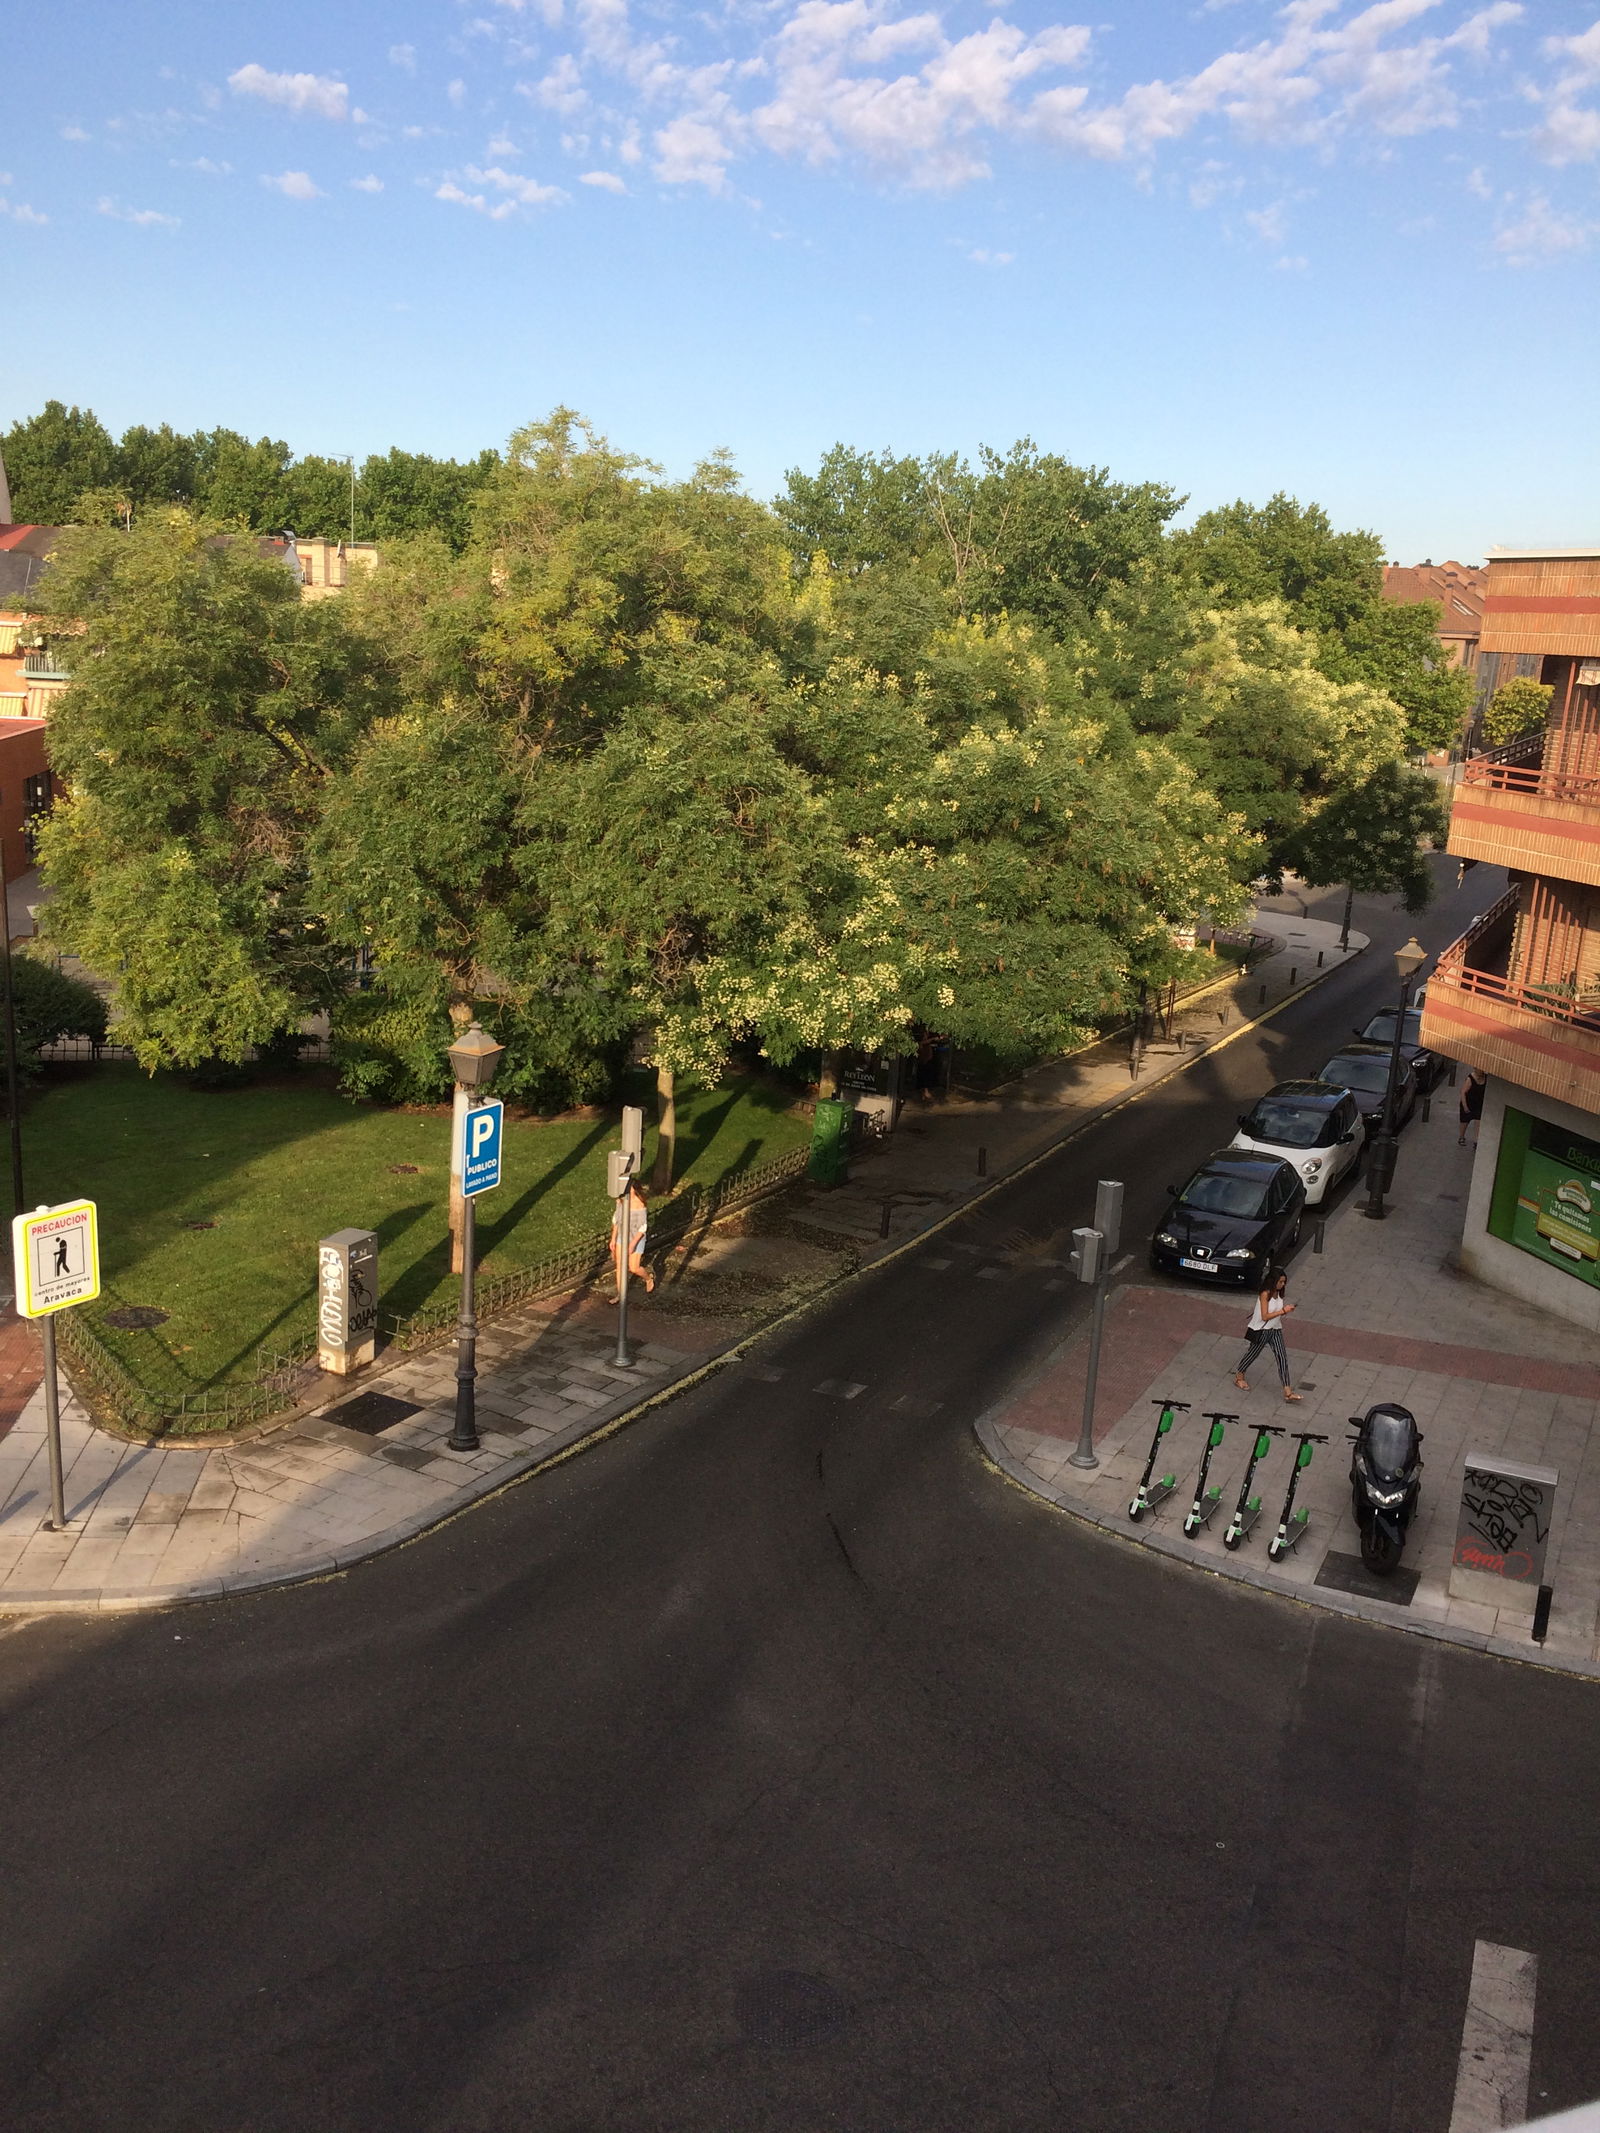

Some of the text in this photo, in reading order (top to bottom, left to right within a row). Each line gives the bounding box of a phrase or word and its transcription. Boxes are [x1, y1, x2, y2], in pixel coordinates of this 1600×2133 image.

[473, 1115, 494, 1158] P
[467, 1158, 497, 1176] PUBLICO
[32, 1213, 87, 1235] PRECAUCION
[65, 1276, 90, 1288] mayores
[44, 1288, 82, 1304] Aravaca
